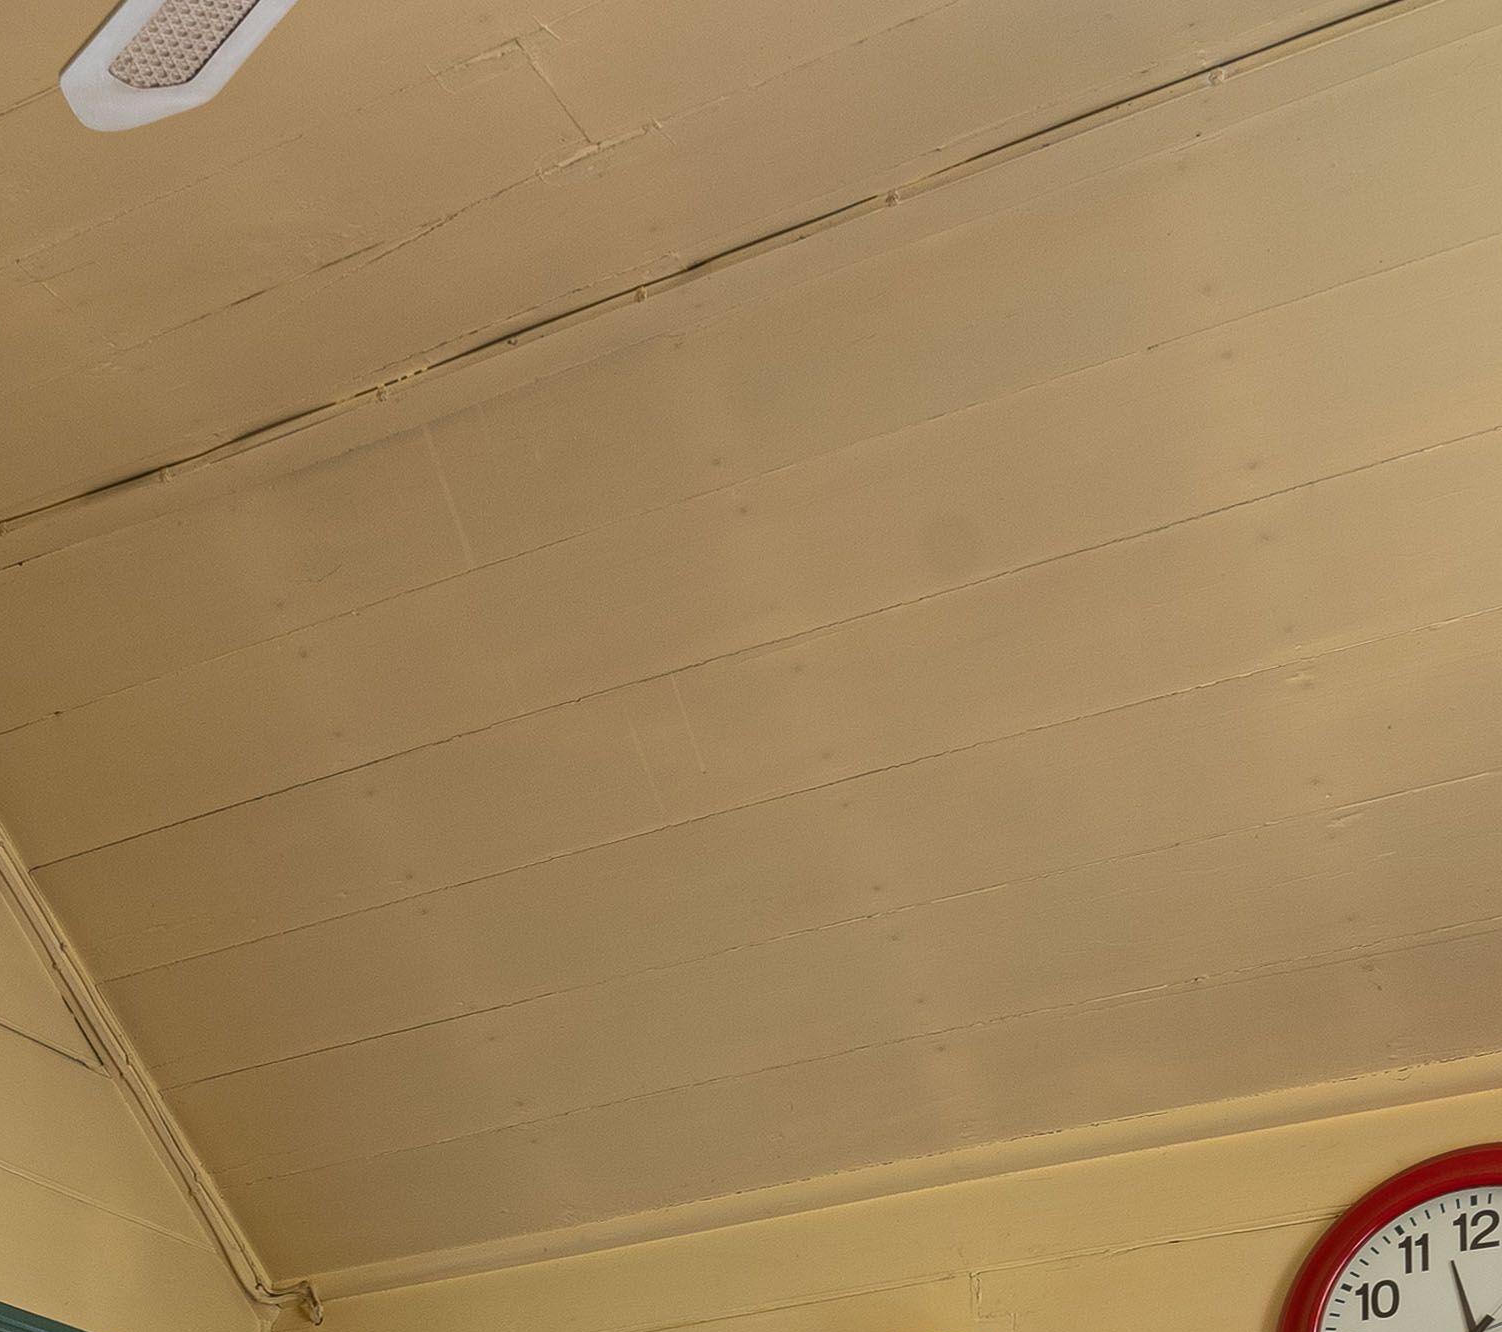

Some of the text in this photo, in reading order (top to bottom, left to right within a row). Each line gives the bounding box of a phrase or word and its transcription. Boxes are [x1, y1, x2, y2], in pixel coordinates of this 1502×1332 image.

[1452, 1209, 1501, 1252] 12
[1398, 1233, 1430, 1274] 11
[1355, 1279, 1400, 1321] 10
